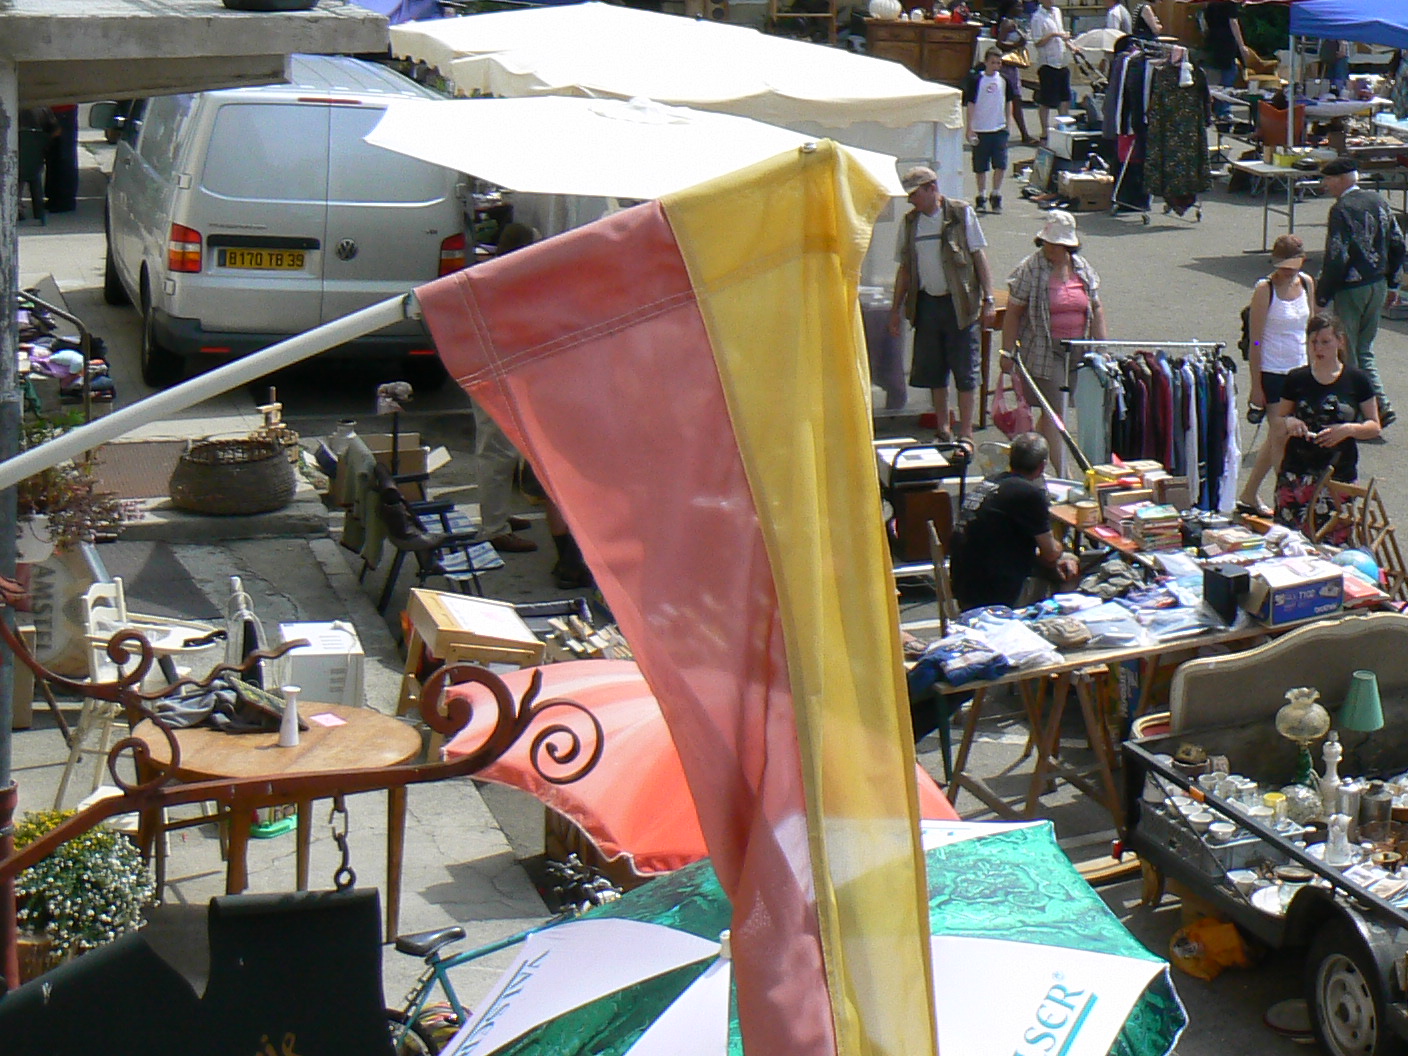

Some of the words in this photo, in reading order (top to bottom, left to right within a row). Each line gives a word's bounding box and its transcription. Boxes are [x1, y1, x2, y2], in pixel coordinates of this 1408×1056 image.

[229, 252, 262, 266] 8170
[268, 253, 283, 267] TB
[288, 253, 305, 268] 39
[32, 564, 55, 652] AMSTEL
